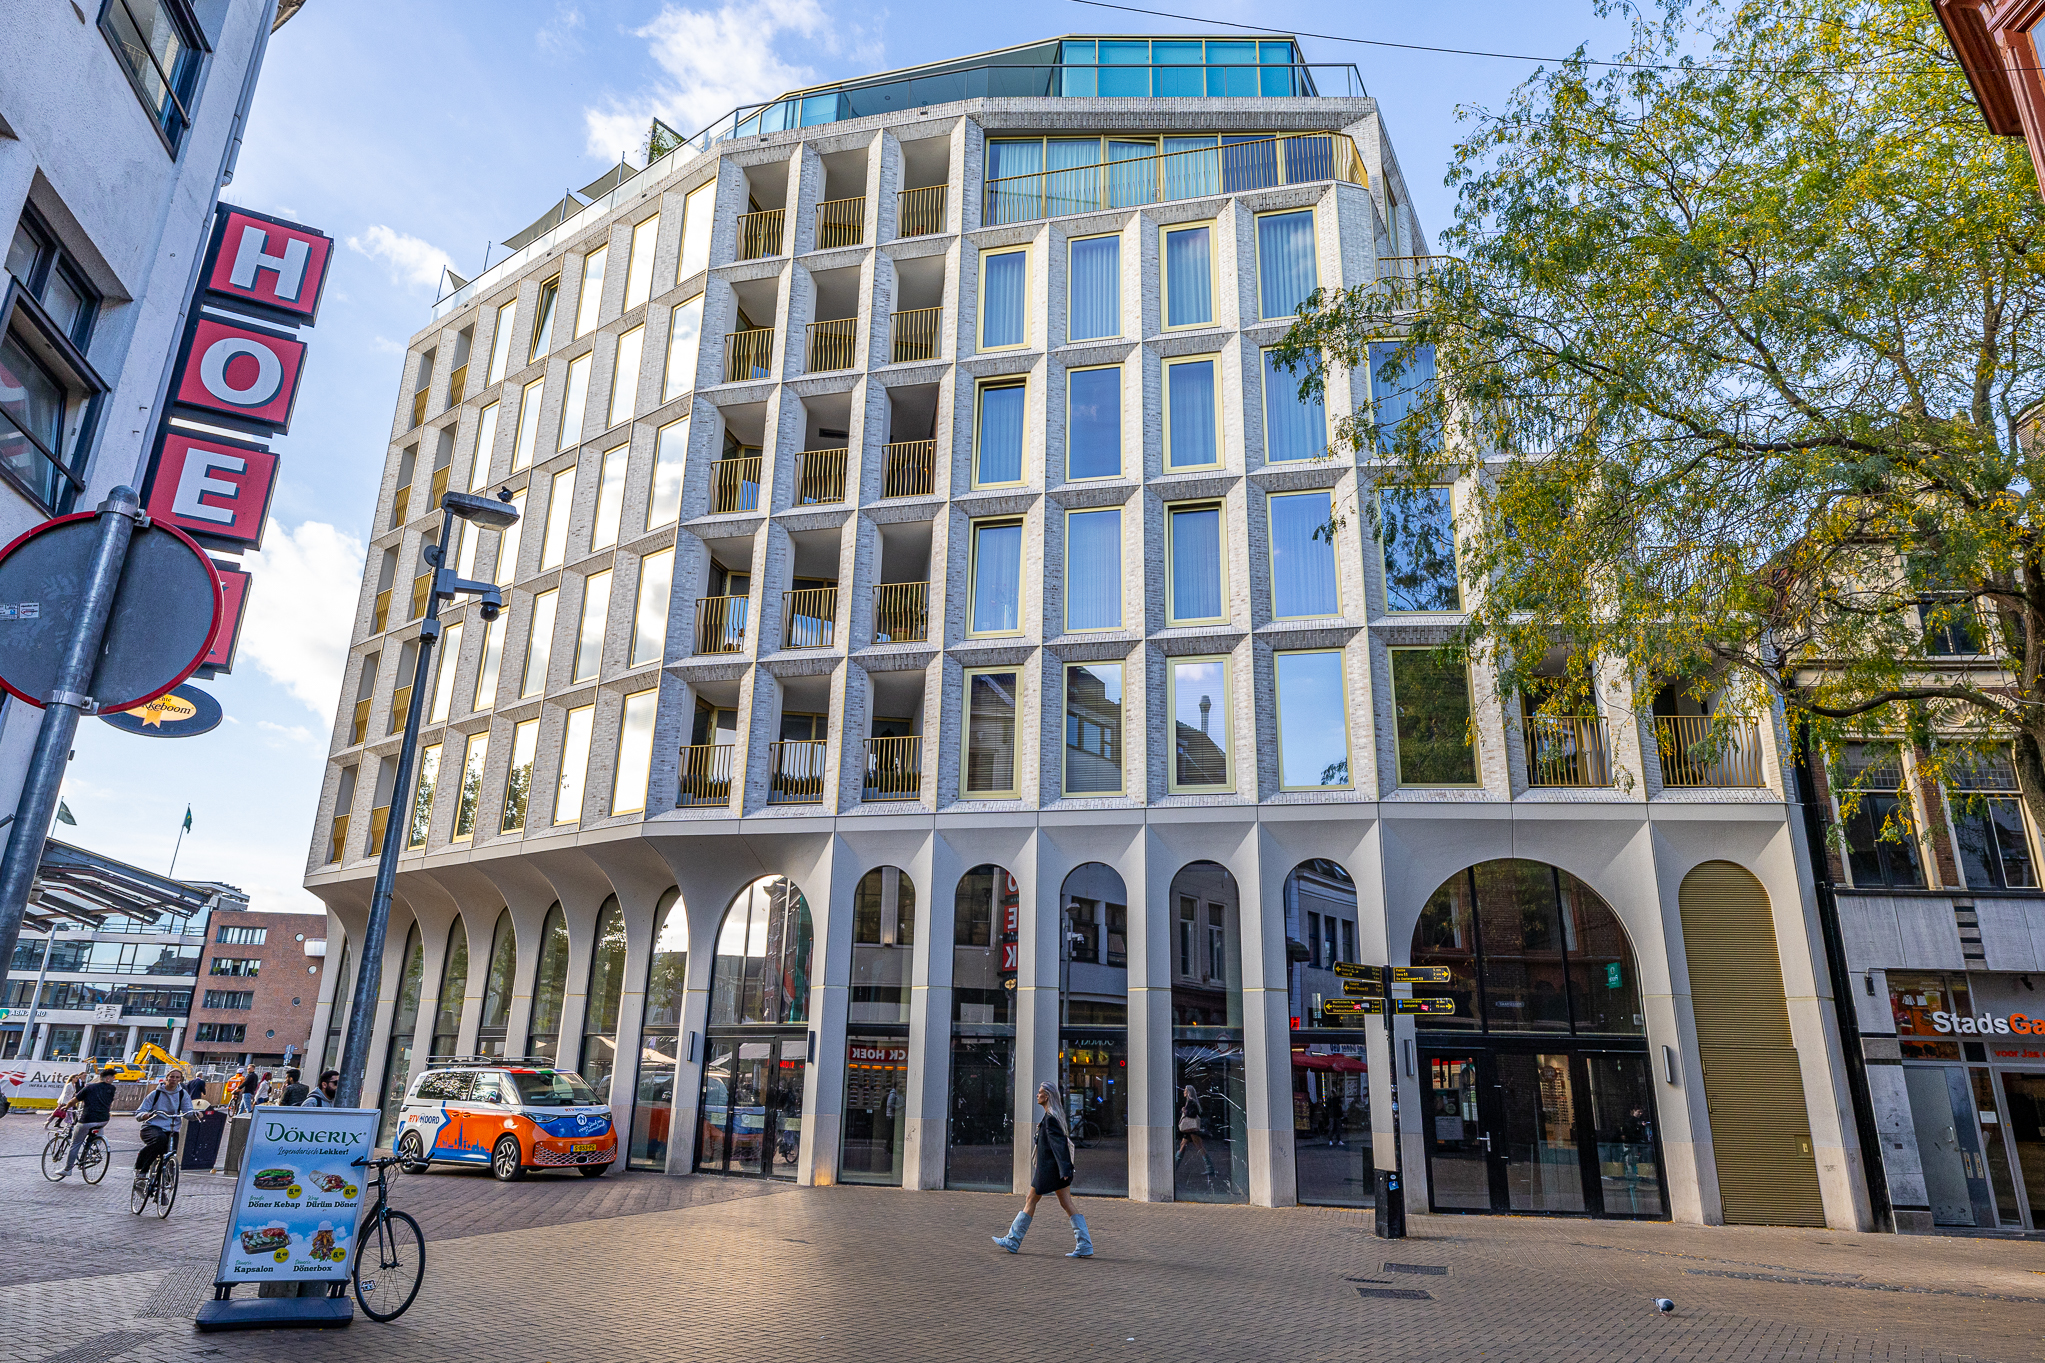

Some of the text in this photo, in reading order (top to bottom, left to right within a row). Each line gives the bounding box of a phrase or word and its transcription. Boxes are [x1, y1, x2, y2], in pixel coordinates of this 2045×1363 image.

[1932, 1011, 2045, 1035] StadsGa
[1995, 1049, 2041, 1058] voor Jas
[408, 1114, 420, 1123] RTV
[265, 1122, 363, 1147] DÖNERIX
[247, 1200, 301, 1209] Döner Kebap
[305, 1200, 358, 1208] Dürüm Döner
[233, 1265, 274, 1275] Kapsalon
[292, 1264, 333, 1272] Dönerbox
